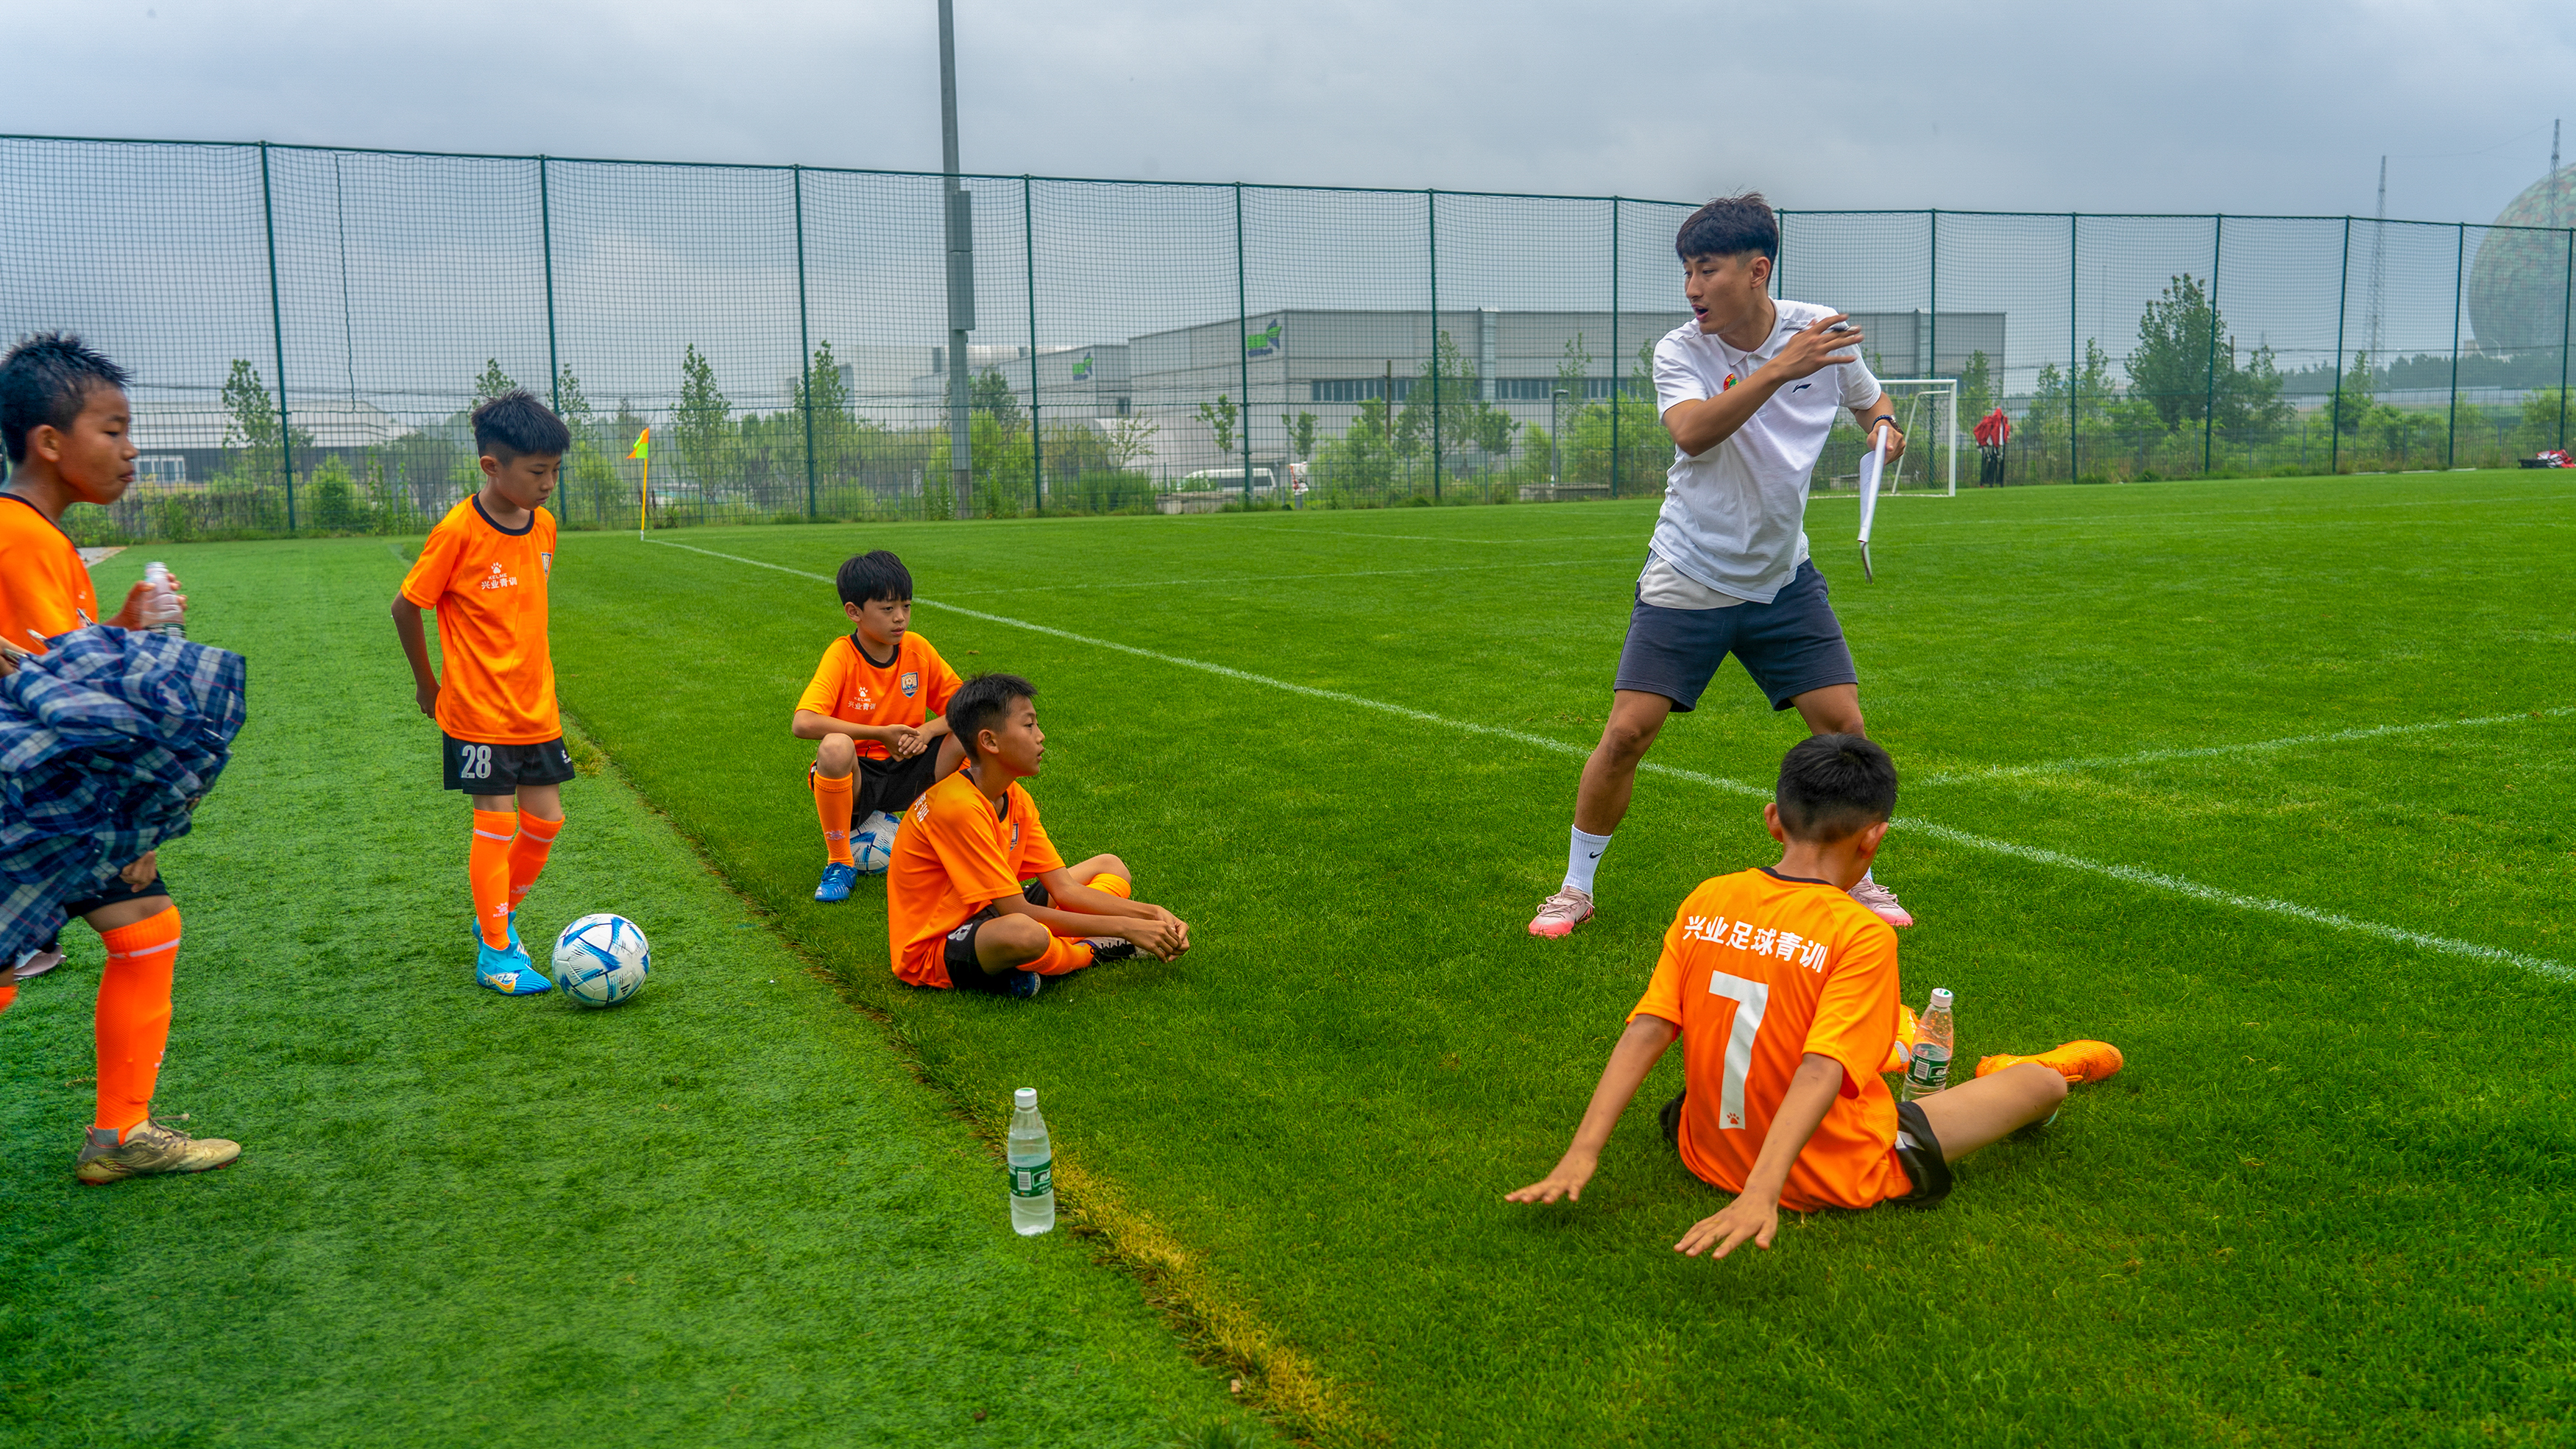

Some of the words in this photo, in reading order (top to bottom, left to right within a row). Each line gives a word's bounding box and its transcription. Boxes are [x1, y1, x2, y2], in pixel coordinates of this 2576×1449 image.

[481, 576, 517, 590] 兴业青训
[847, 701, 876, 711] 兴业青训
[461, 745, 492, 779] 28
[1682, 915, 1828, 973] 兴业足球青训
[1708, 970, 1769, 1130] 7
